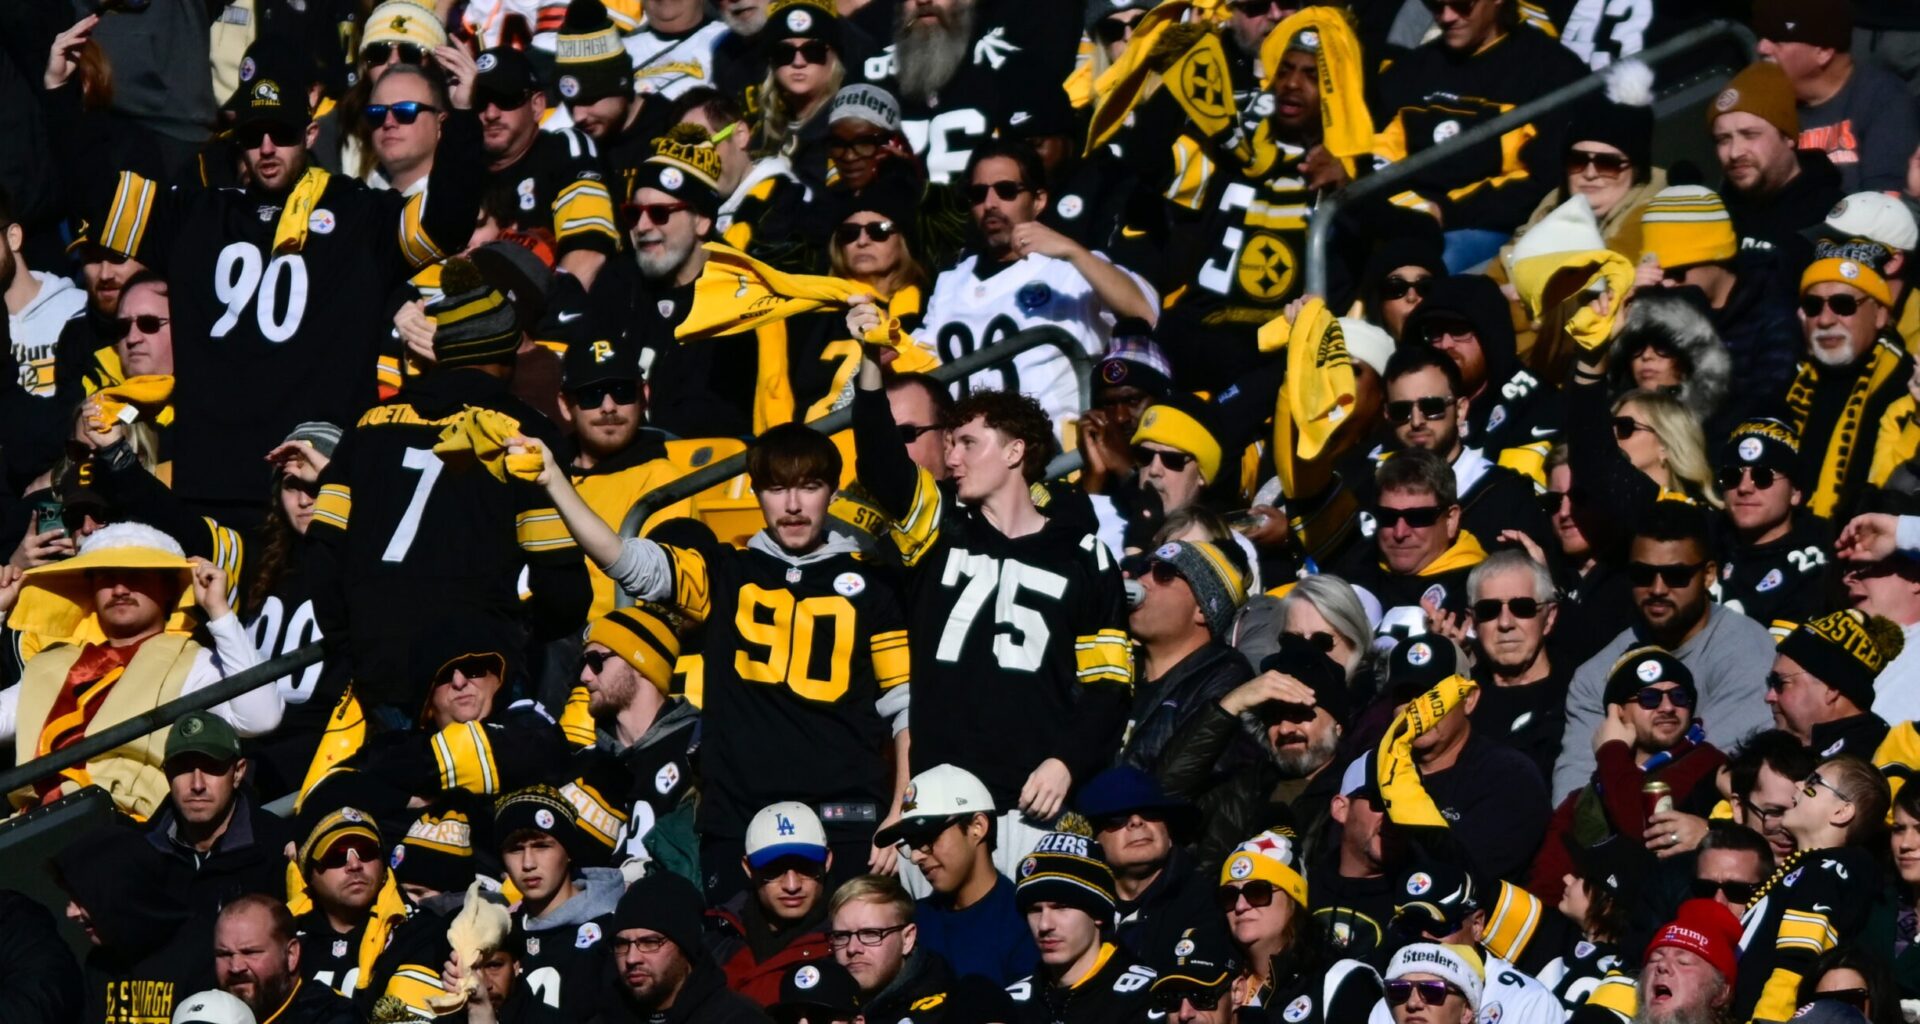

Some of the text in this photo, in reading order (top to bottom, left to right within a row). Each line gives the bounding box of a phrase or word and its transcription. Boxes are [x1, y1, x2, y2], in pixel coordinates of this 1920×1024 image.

[210, 241, 309, 343] 90
[381, 446, 445, 563] 7
[1787, 545, 1829, 572] 22
[936, 547, 1068, 672] 75
[734, 582, 857, 702] 90
[775, 813, 795, 836] LA
[1402, 950, 1459, 973] Steelers
[1665, 924, 1709, 947] Trump
